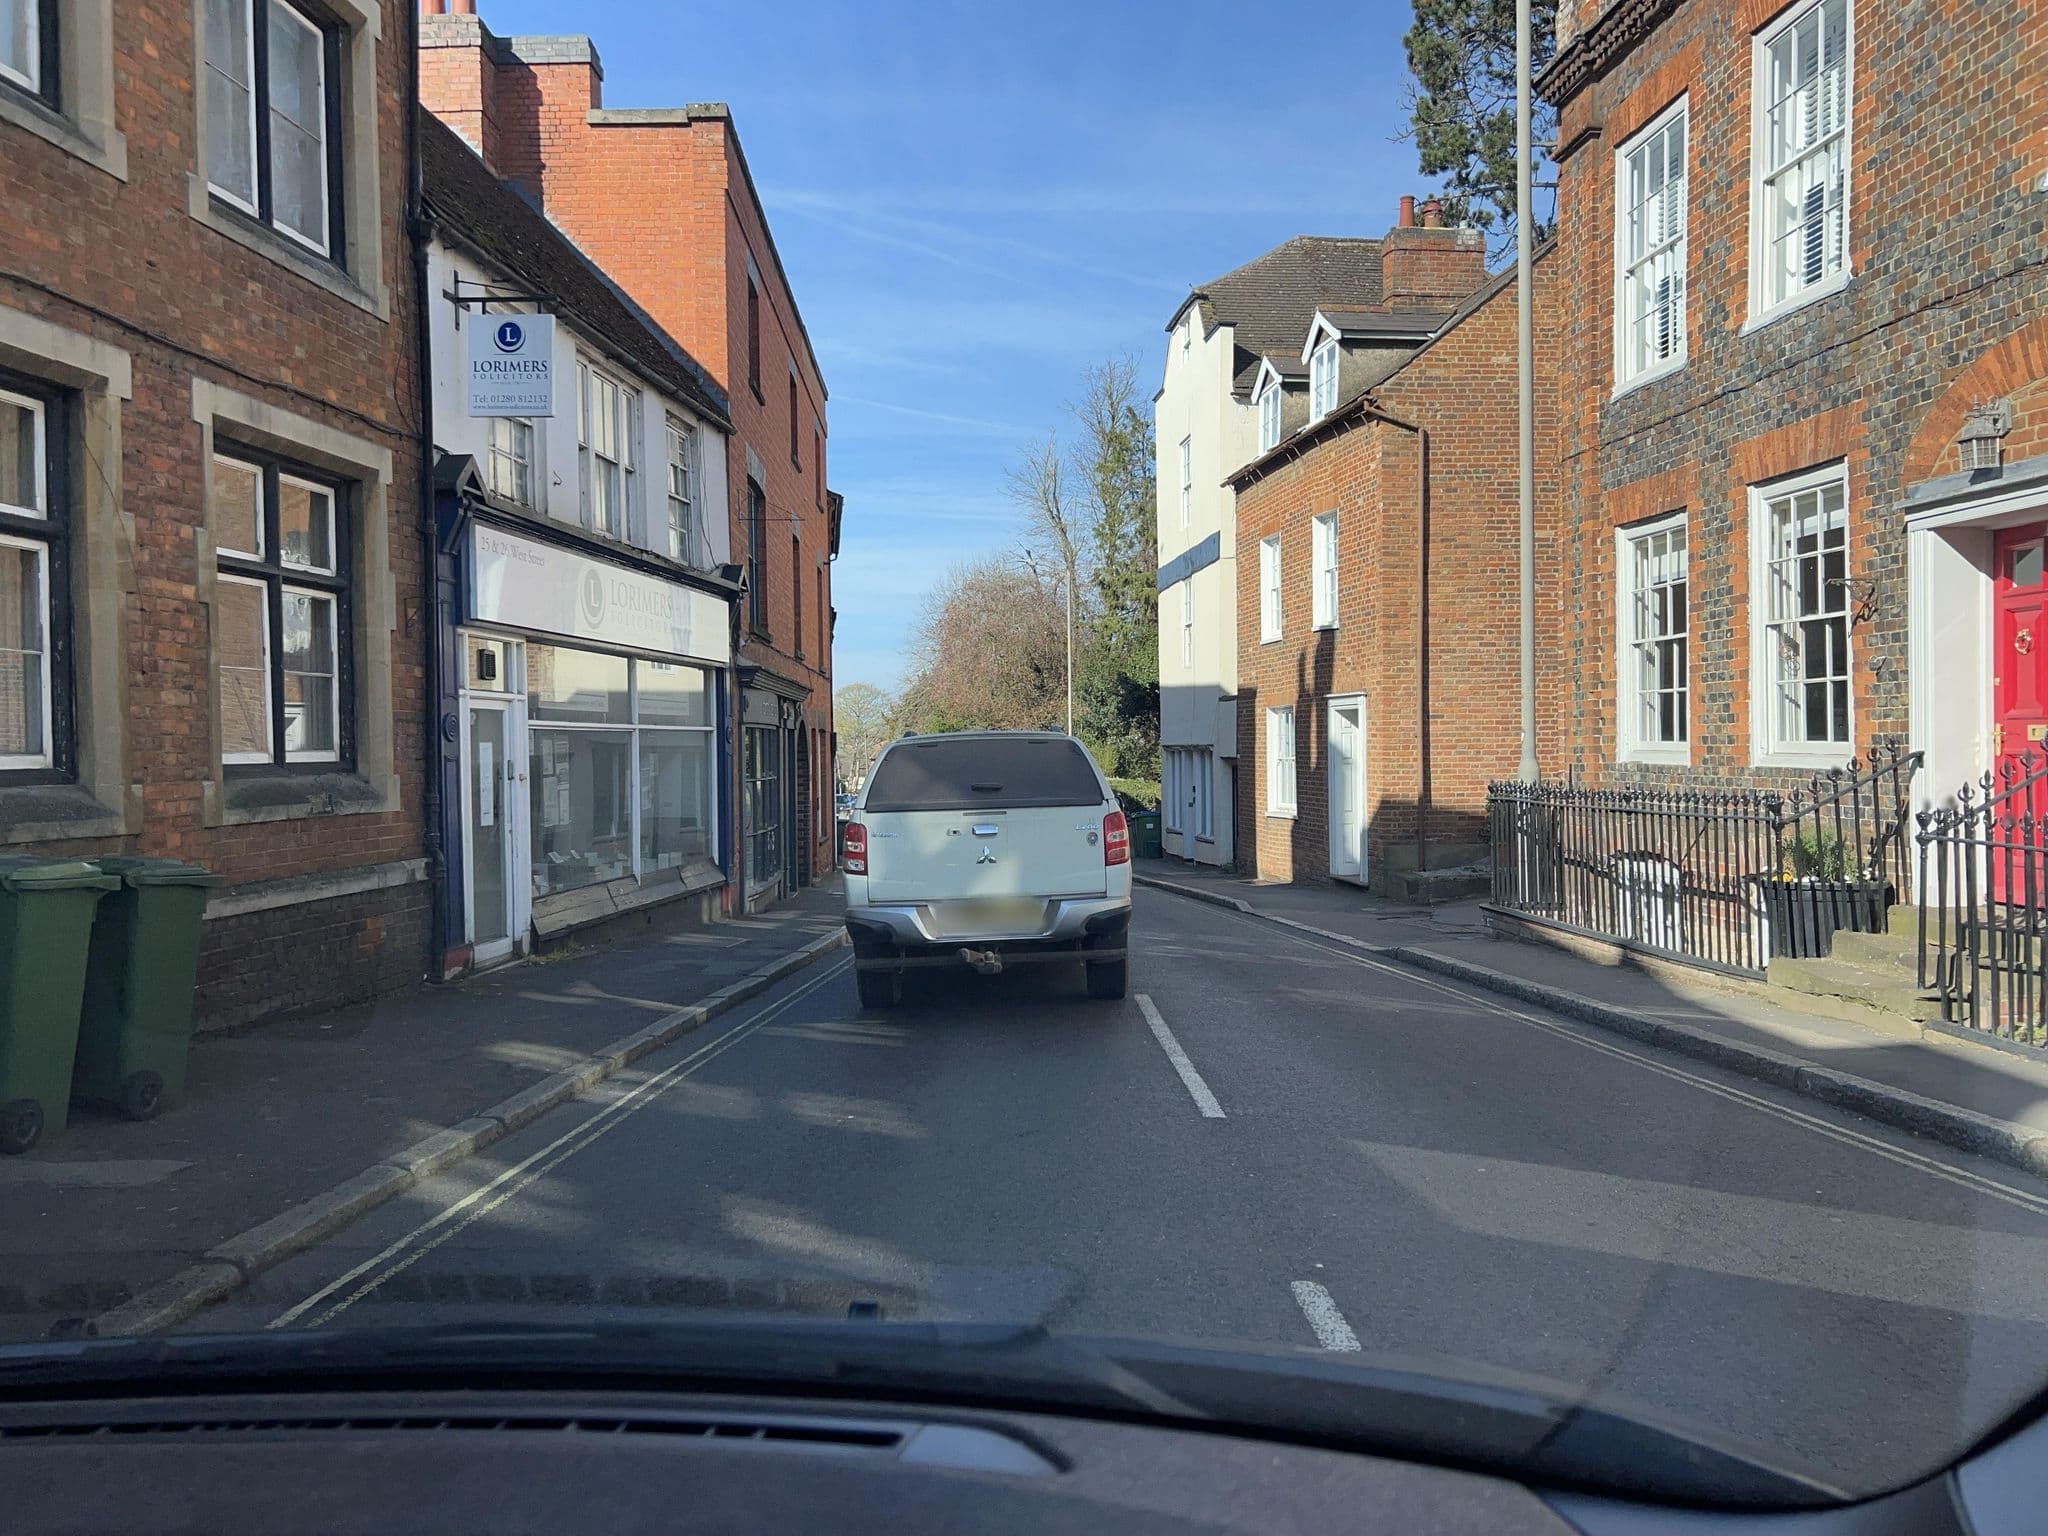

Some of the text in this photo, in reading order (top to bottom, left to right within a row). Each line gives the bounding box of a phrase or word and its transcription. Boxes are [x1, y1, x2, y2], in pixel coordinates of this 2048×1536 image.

[505, 327, 517, 342] L
[473, 360, 548, 373] LORIMERS
[472, 394, 488, 403] Tel:
[490, 394, 516, 403] 01280
[608, 578, 673, 620] LORIMERS
